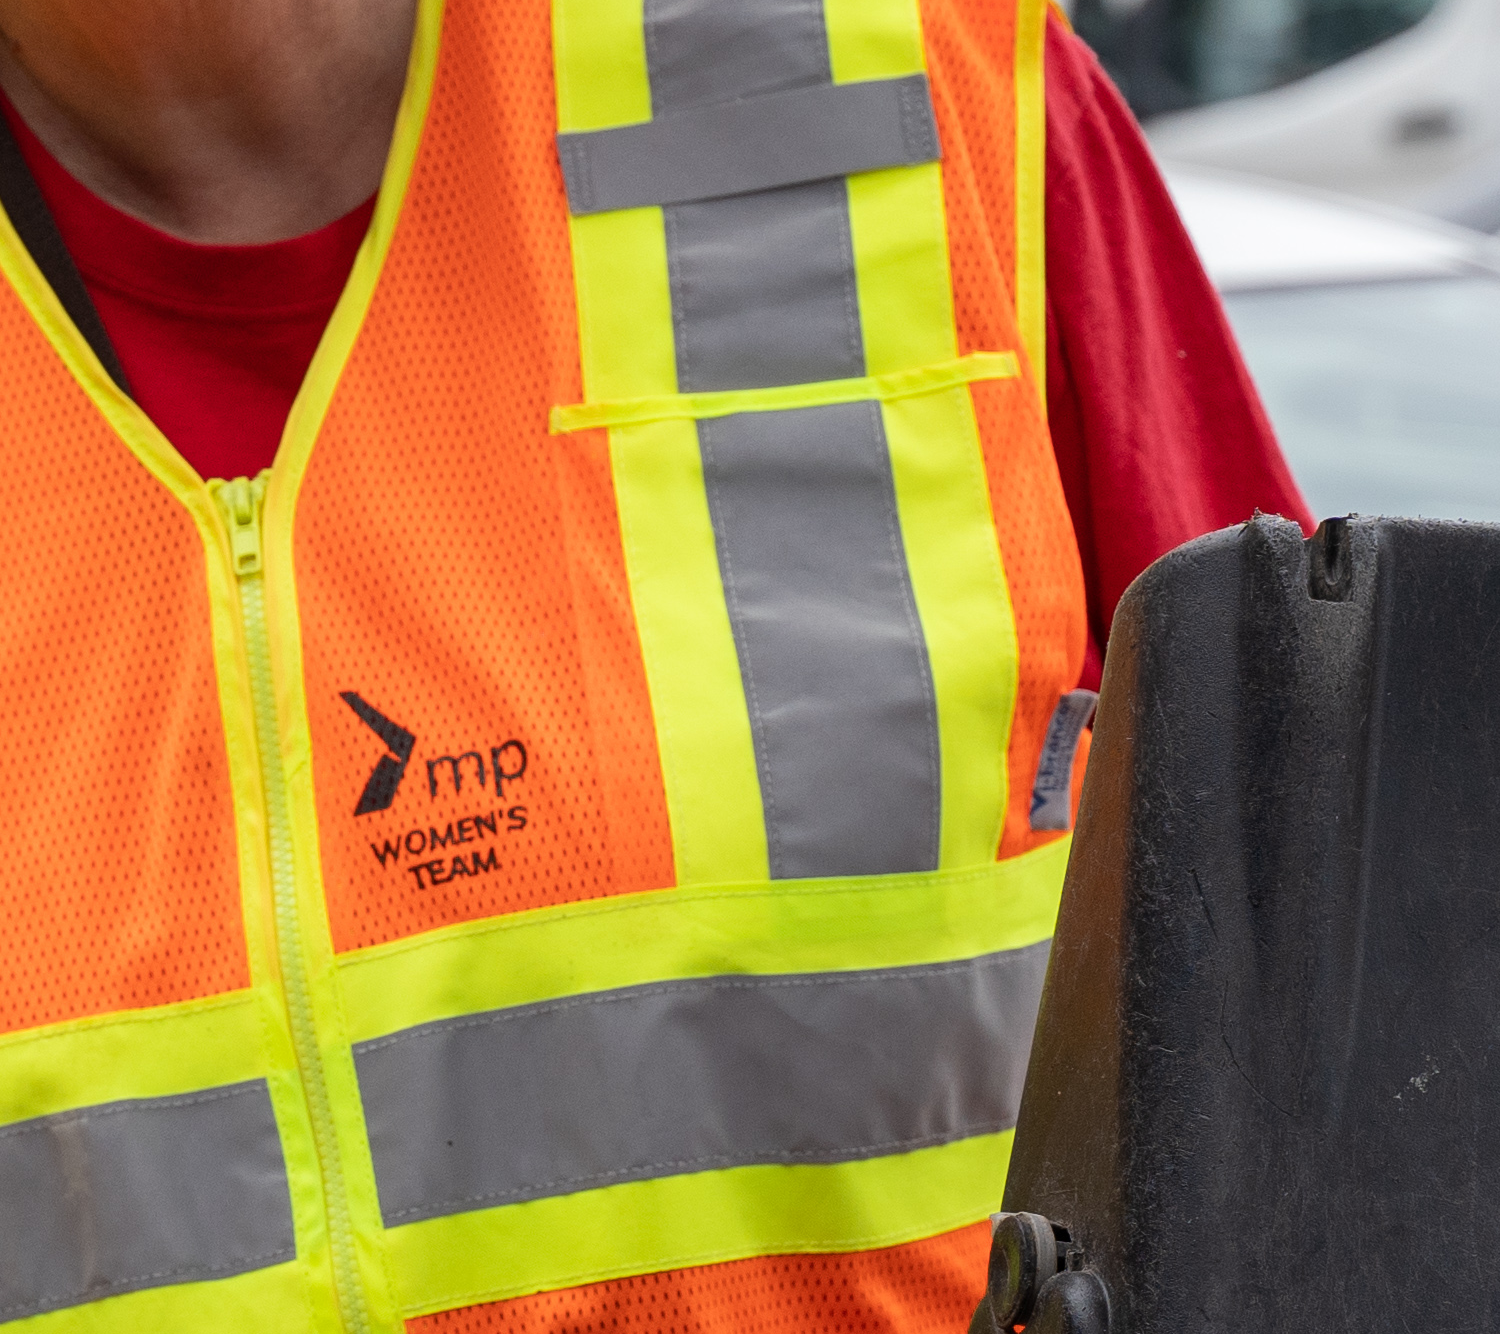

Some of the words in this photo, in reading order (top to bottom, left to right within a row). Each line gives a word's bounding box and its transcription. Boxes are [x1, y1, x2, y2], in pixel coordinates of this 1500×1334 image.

[425, 739, 528, 797] mp
[370, 805, 529, 867] WOMEN'S
[407, 846, 503, 890] TEAM
